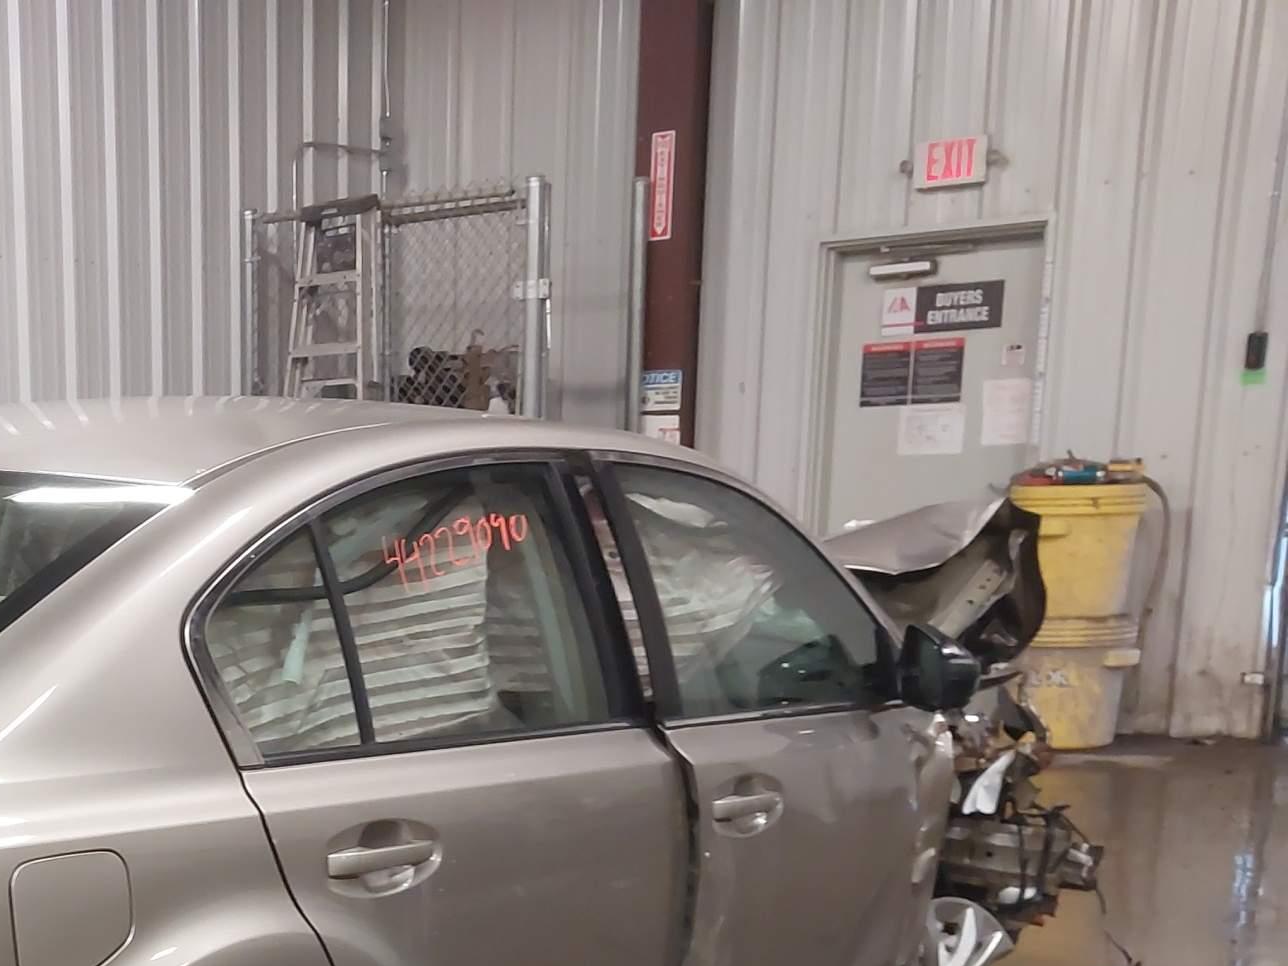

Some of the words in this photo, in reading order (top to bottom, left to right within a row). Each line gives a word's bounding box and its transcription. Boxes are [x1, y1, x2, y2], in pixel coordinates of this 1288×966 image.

[926, 138, 976, 181] EXIT
[936, 289, 983, 307] BUYERS
[927, 306, 989, 325] ENTRANCE
[381, 513, 528, 592] 44229090
